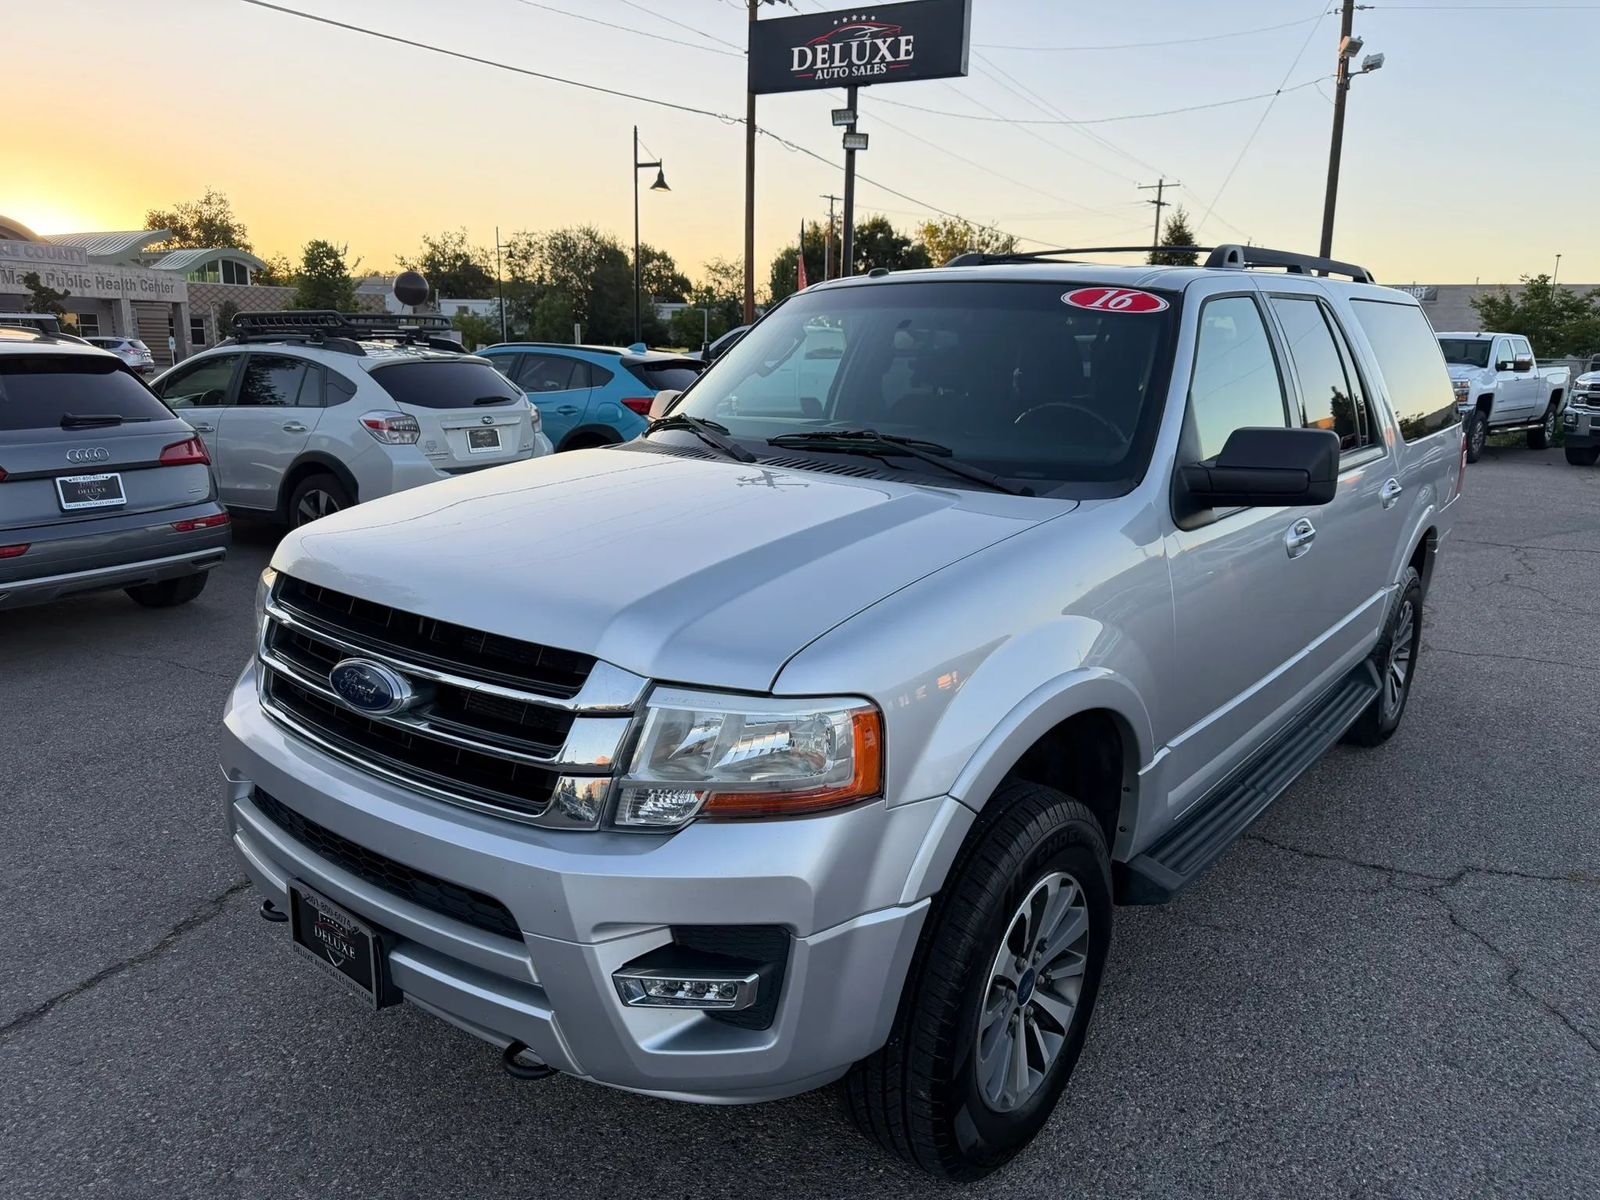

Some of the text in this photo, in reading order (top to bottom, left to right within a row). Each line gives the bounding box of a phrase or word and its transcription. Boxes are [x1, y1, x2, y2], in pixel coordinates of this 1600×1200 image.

[791, 35, 914, 71] DELUXE
[815, 63, 887, 80] AUTO SALES
[23, 245, 83, 261] COUNTY
[46, 272, 92, 289] Public
[95, 276, 137, 292] Health
[140, 279, 175, 294] Center
[1086, 289, 1143, 309] 16
[314, 925, 356, 959] DELUXE
